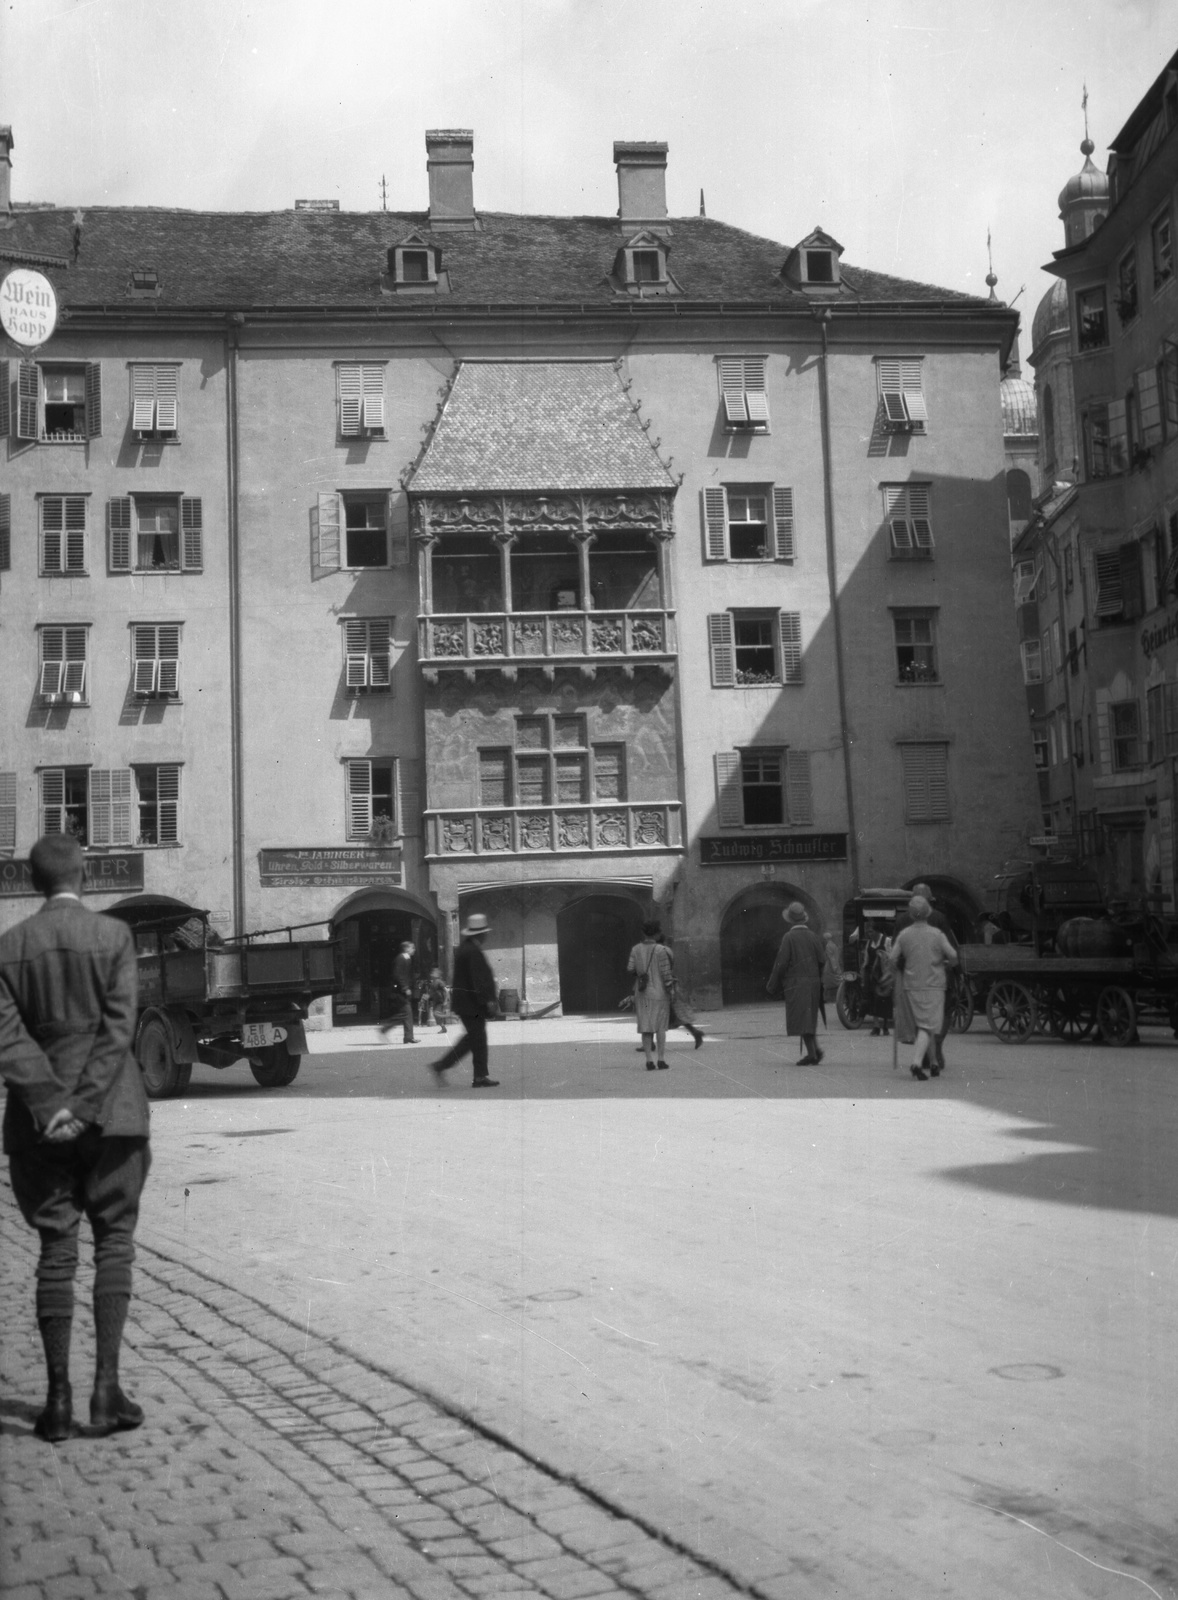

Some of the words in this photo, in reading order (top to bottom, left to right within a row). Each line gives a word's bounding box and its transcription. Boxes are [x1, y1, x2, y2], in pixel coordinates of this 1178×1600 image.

[4, 280, 50, 308] Wein
[10, 307, 47, 320] HAUS
[710, 840, 764, 859] Ludwig
[768, 838, 837, 857] Schaufler
[83, 859, 130, 876] TER
[299, 860, 323, 871] Gold
[246, 1034, 267, 1047] 488
[273, 1028, 283, 1041] A
